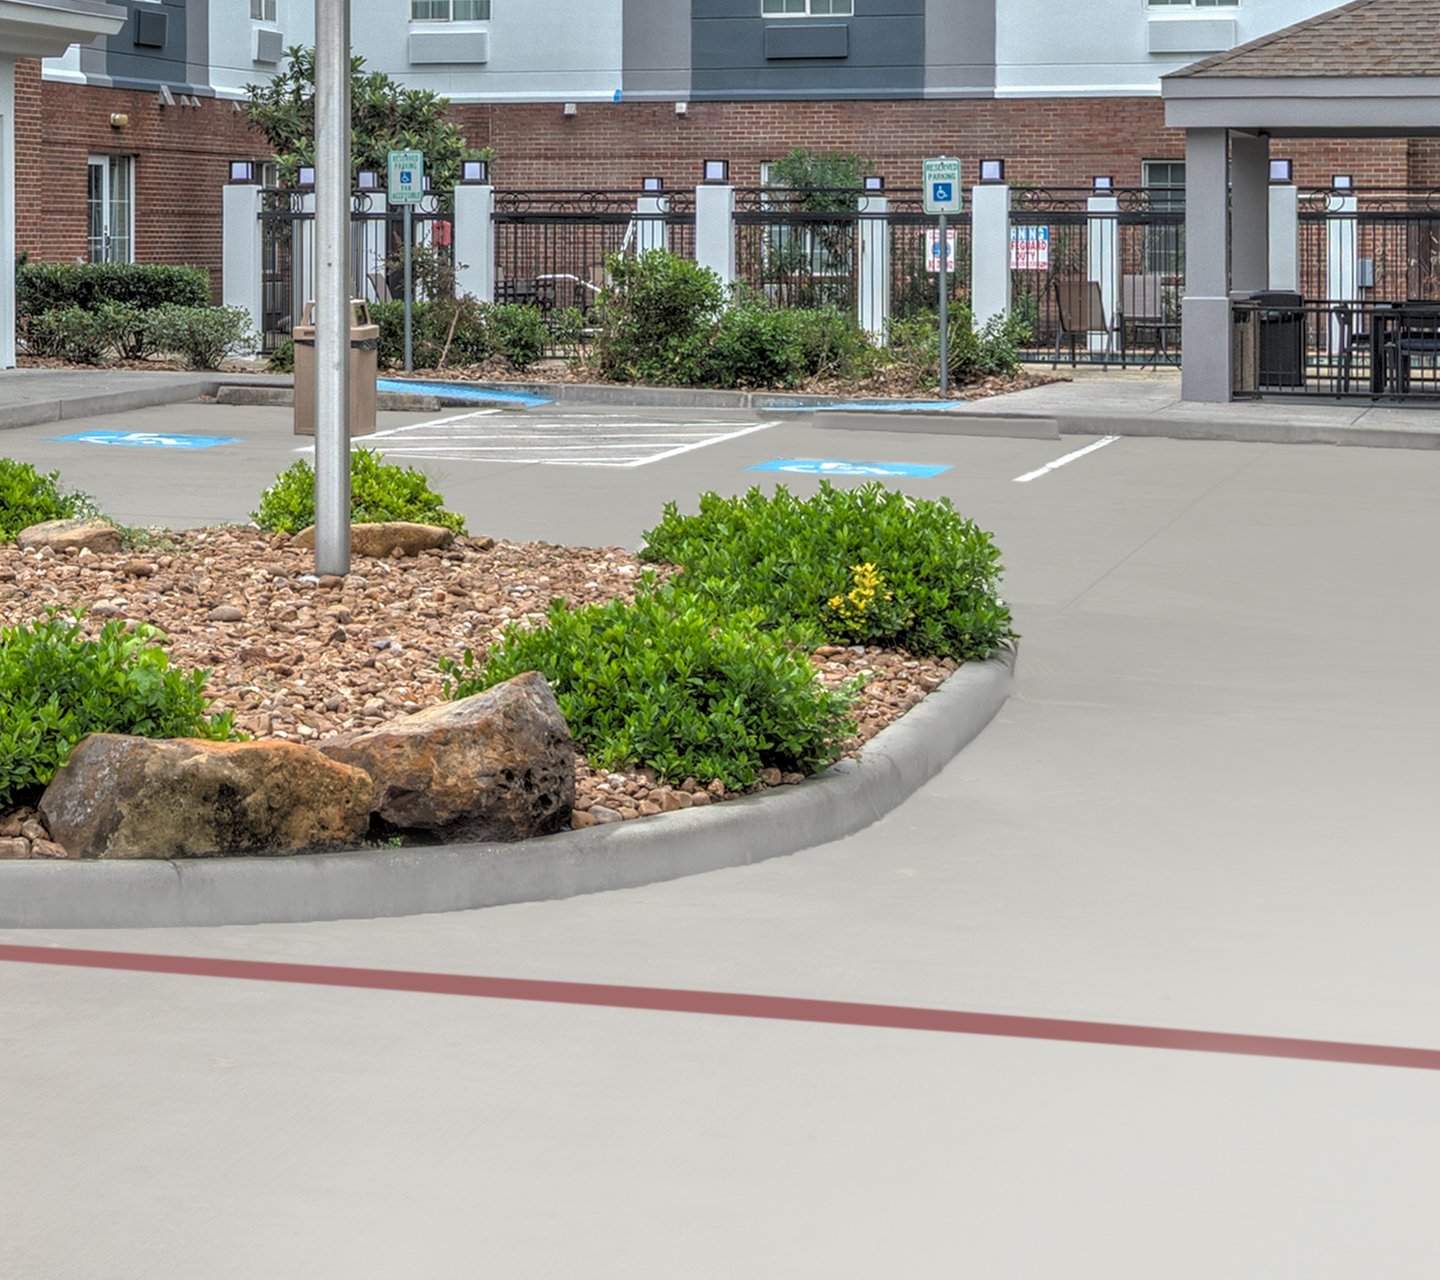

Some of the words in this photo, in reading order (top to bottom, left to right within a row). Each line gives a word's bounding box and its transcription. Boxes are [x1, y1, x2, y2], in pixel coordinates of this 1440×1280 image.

[394, 162, 417, 170] PARKING
[926, 163, 958, 171] RESERVED
[928, 172, 956, 181] PARKING
